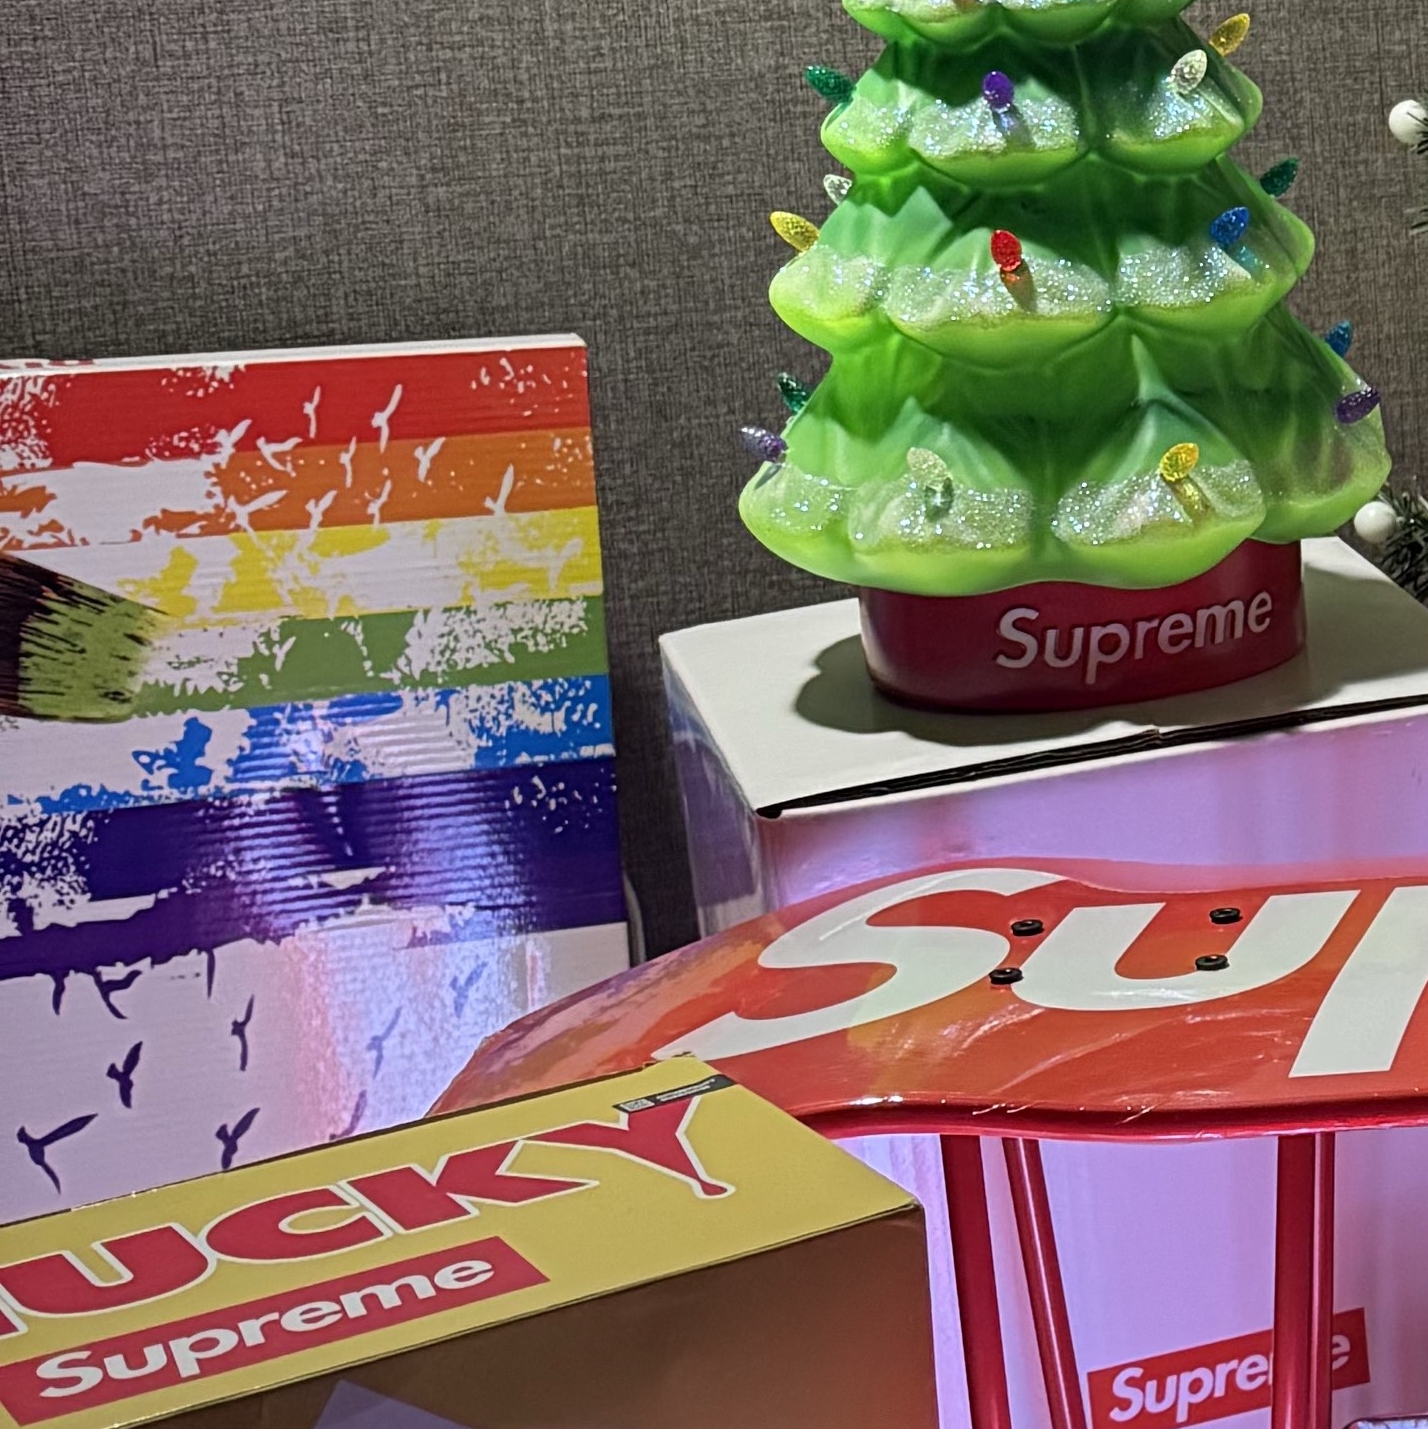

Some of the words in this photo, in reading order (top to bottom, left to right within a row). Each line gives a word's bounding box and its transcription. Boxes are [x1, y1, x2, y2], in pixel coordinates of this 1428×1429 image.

[996, 591, 1273, 684] Supreme
[0, 1096, 736, 1339] UCKY
[35, 1259, 495, 1399] Supreme
